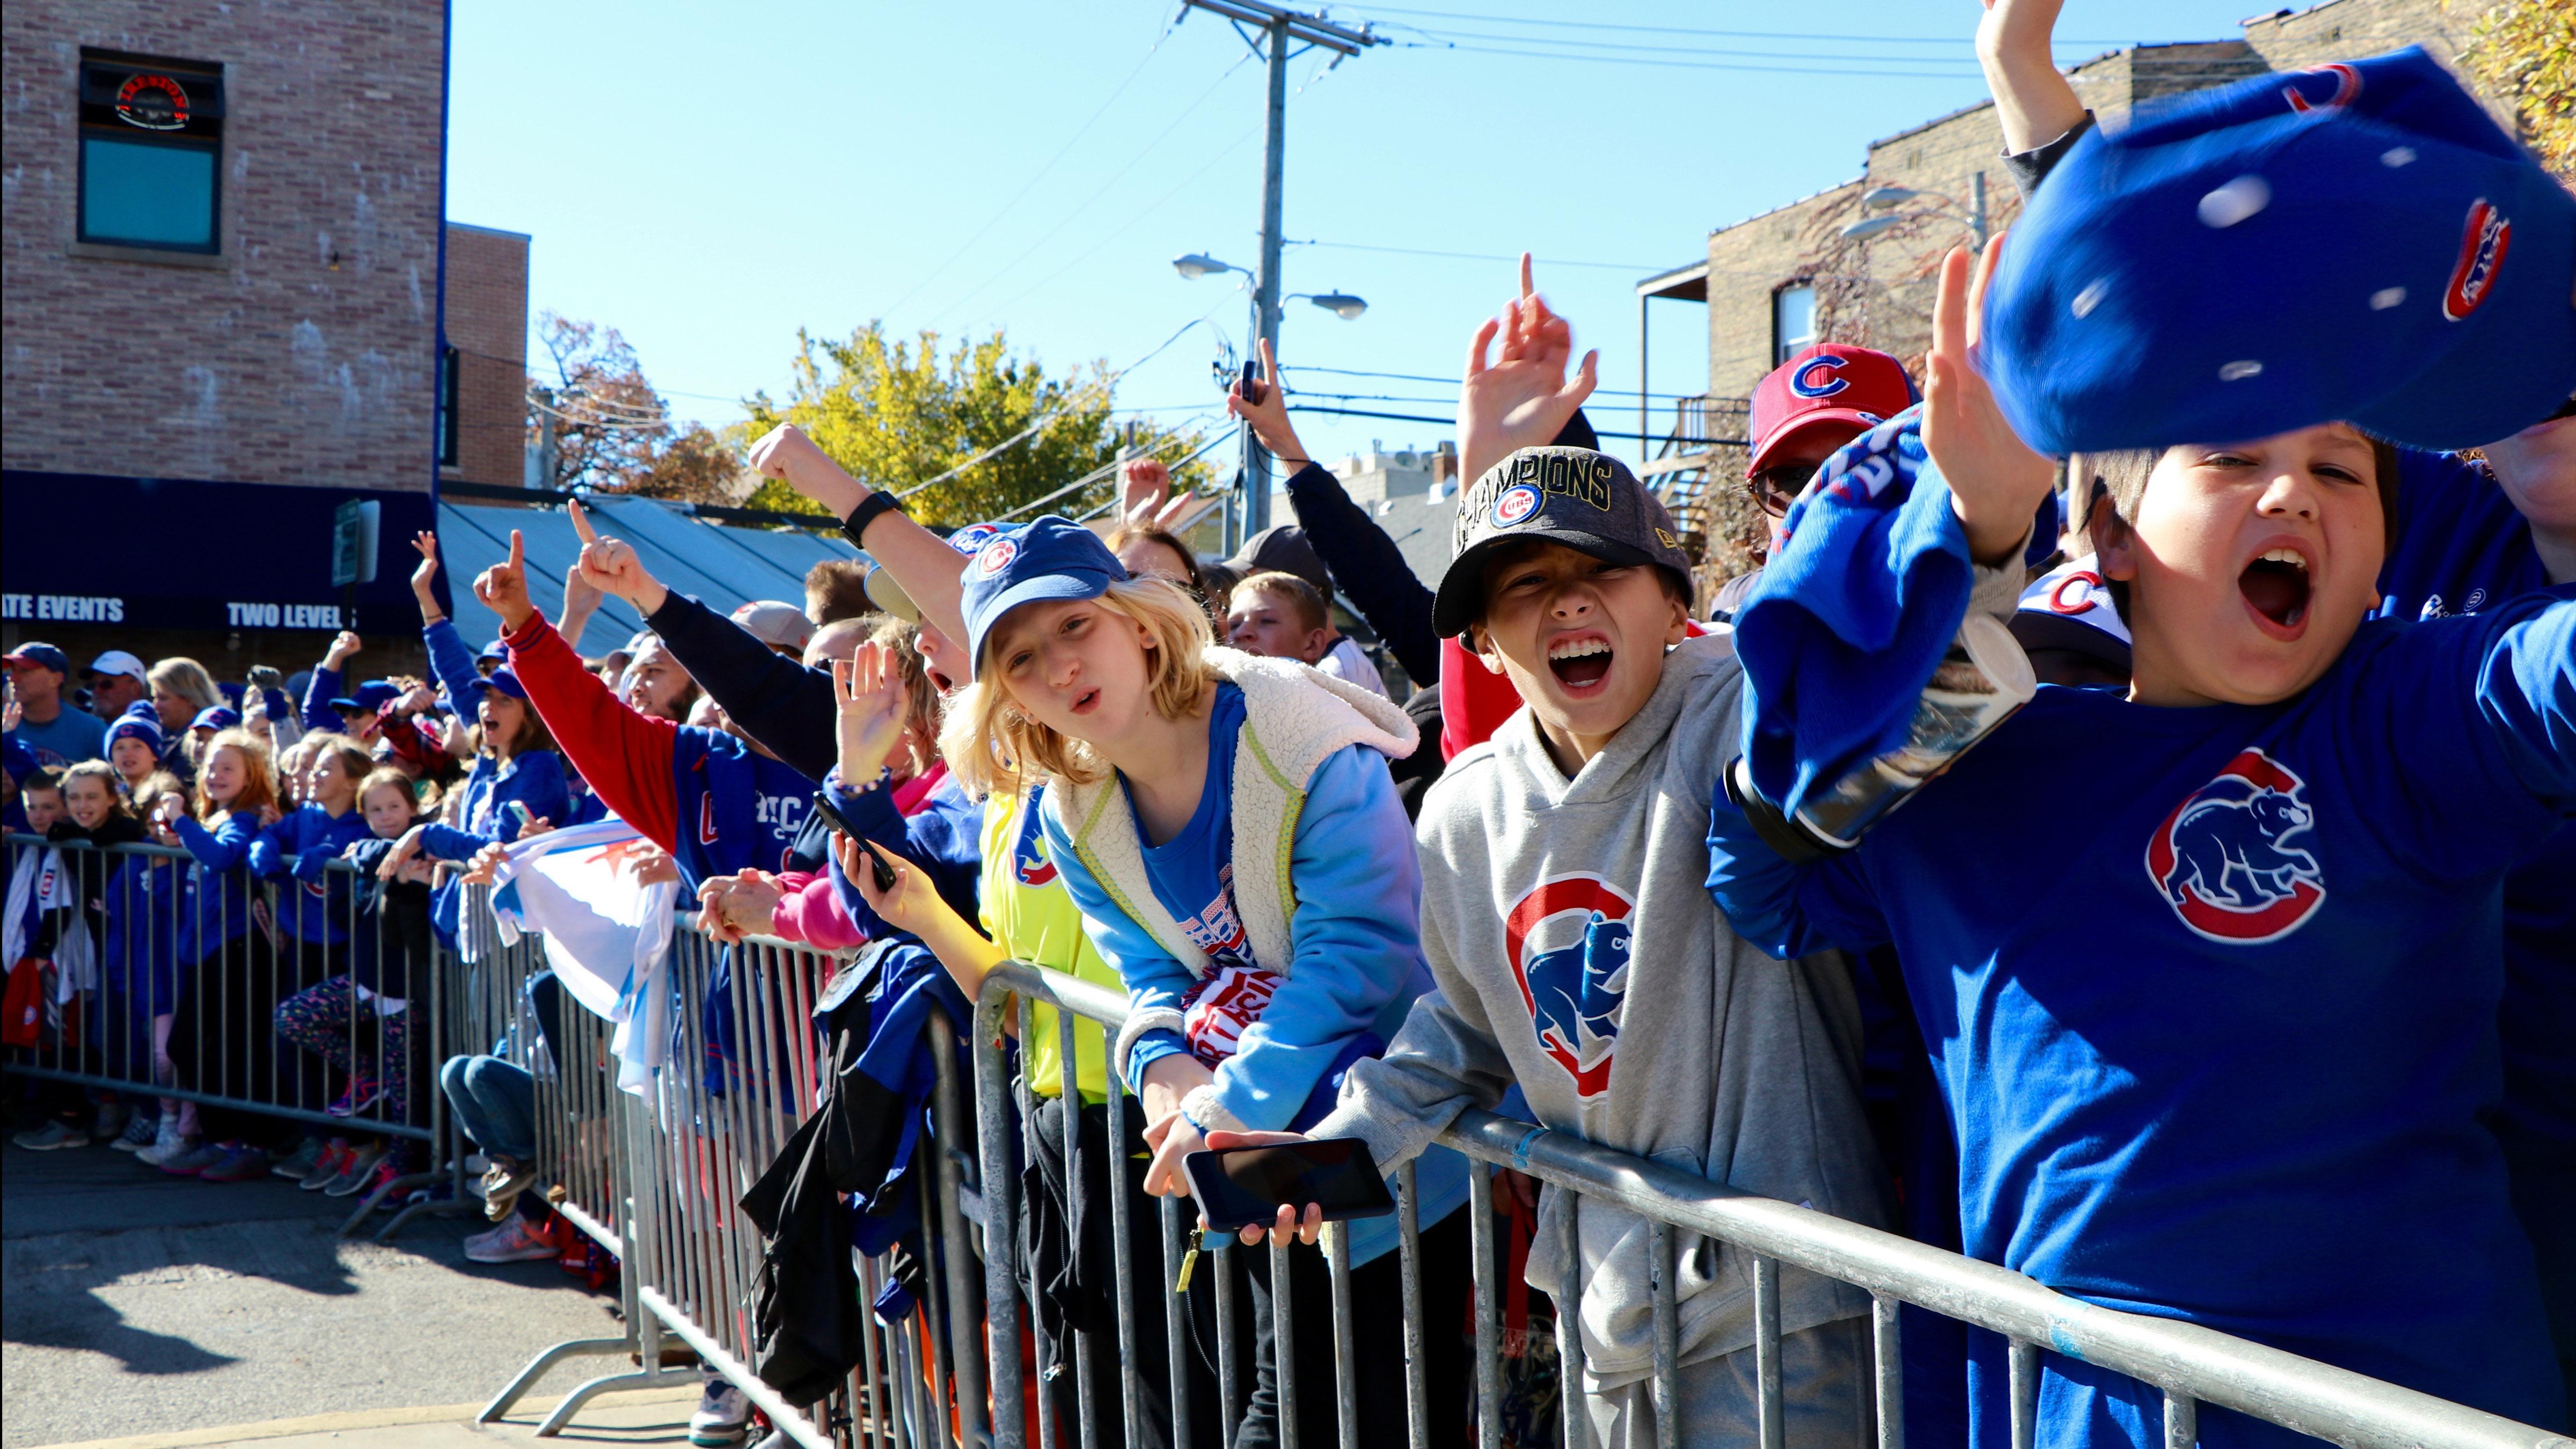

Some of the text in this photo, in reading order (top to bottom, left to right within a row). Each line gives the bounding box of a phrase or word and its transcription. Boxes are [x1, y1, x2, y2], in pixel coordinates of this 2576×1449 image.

[1789, 355, 1851, 399] C
[1455, 454, 1612, 556] CHAMPIONS
[1499, 491, 1533, 518] CUBS
[38, 595, 124, 622] EVENTS
[2049, 570, 2104, 616] C
[227, 602, 280, 627] TWO
